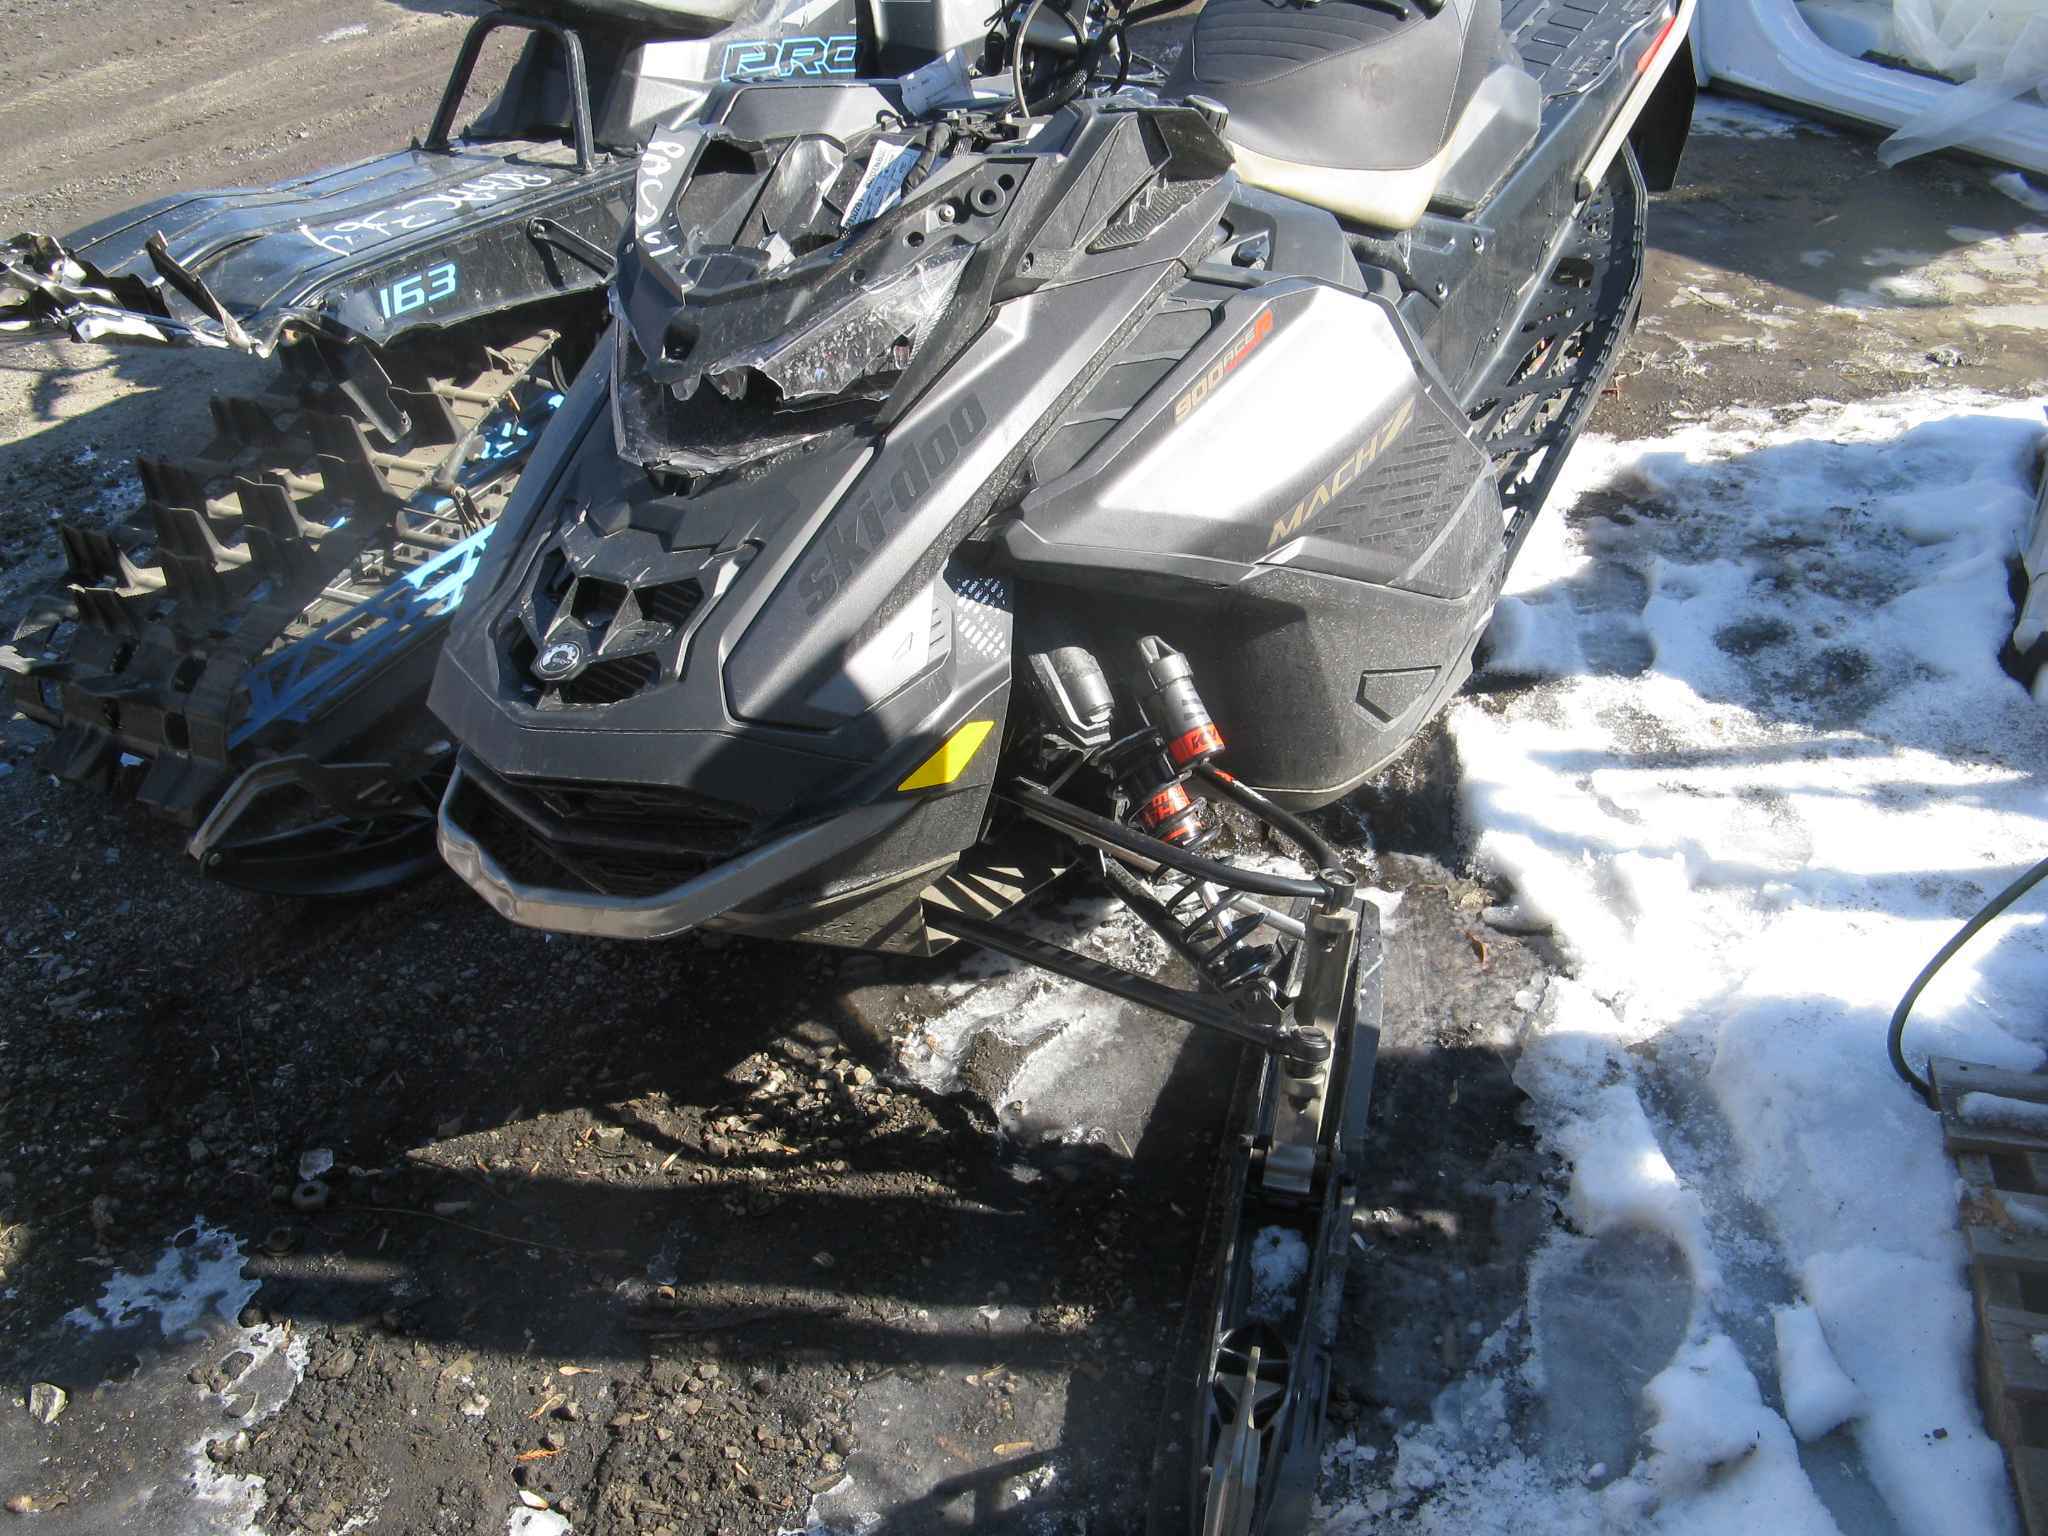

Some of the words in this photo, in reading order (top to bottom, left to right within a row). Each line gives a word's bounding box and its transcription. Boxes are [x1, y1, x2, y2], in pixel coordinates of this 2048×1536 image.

[379, 263, 456, 319] 163
[1174, 360, 1225, 422] 900
[1267, 432, 1378, 548] MACH
[1380, 393, 1416, 451] Z
